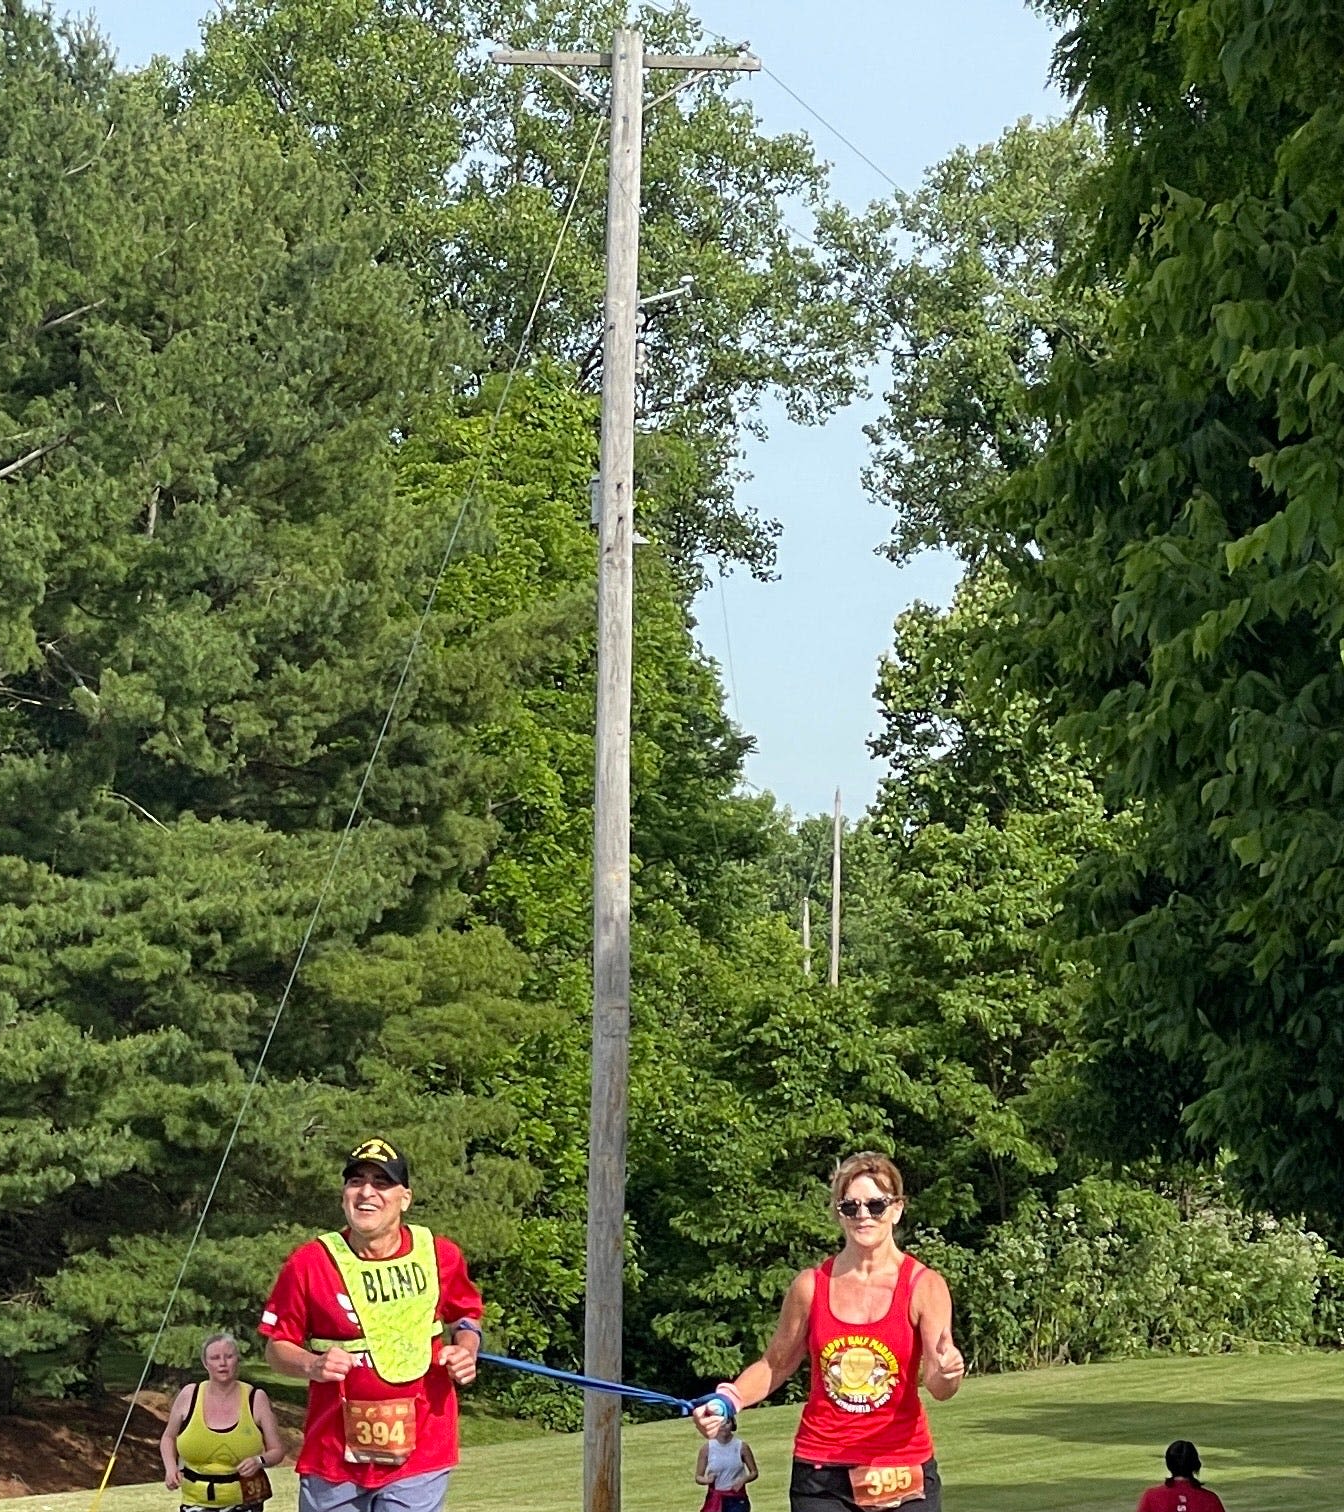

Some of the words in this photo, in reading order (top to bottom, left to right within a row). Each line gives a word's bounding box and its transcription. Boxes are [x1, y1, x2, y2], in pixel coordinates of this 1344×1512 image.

[361, 1262, 428, 1304] BLIND
[847, 1335, 870, 1346] HALF
[356, 1420, 406, 1446] 394
[864, 1466, 912, 1496] 395
